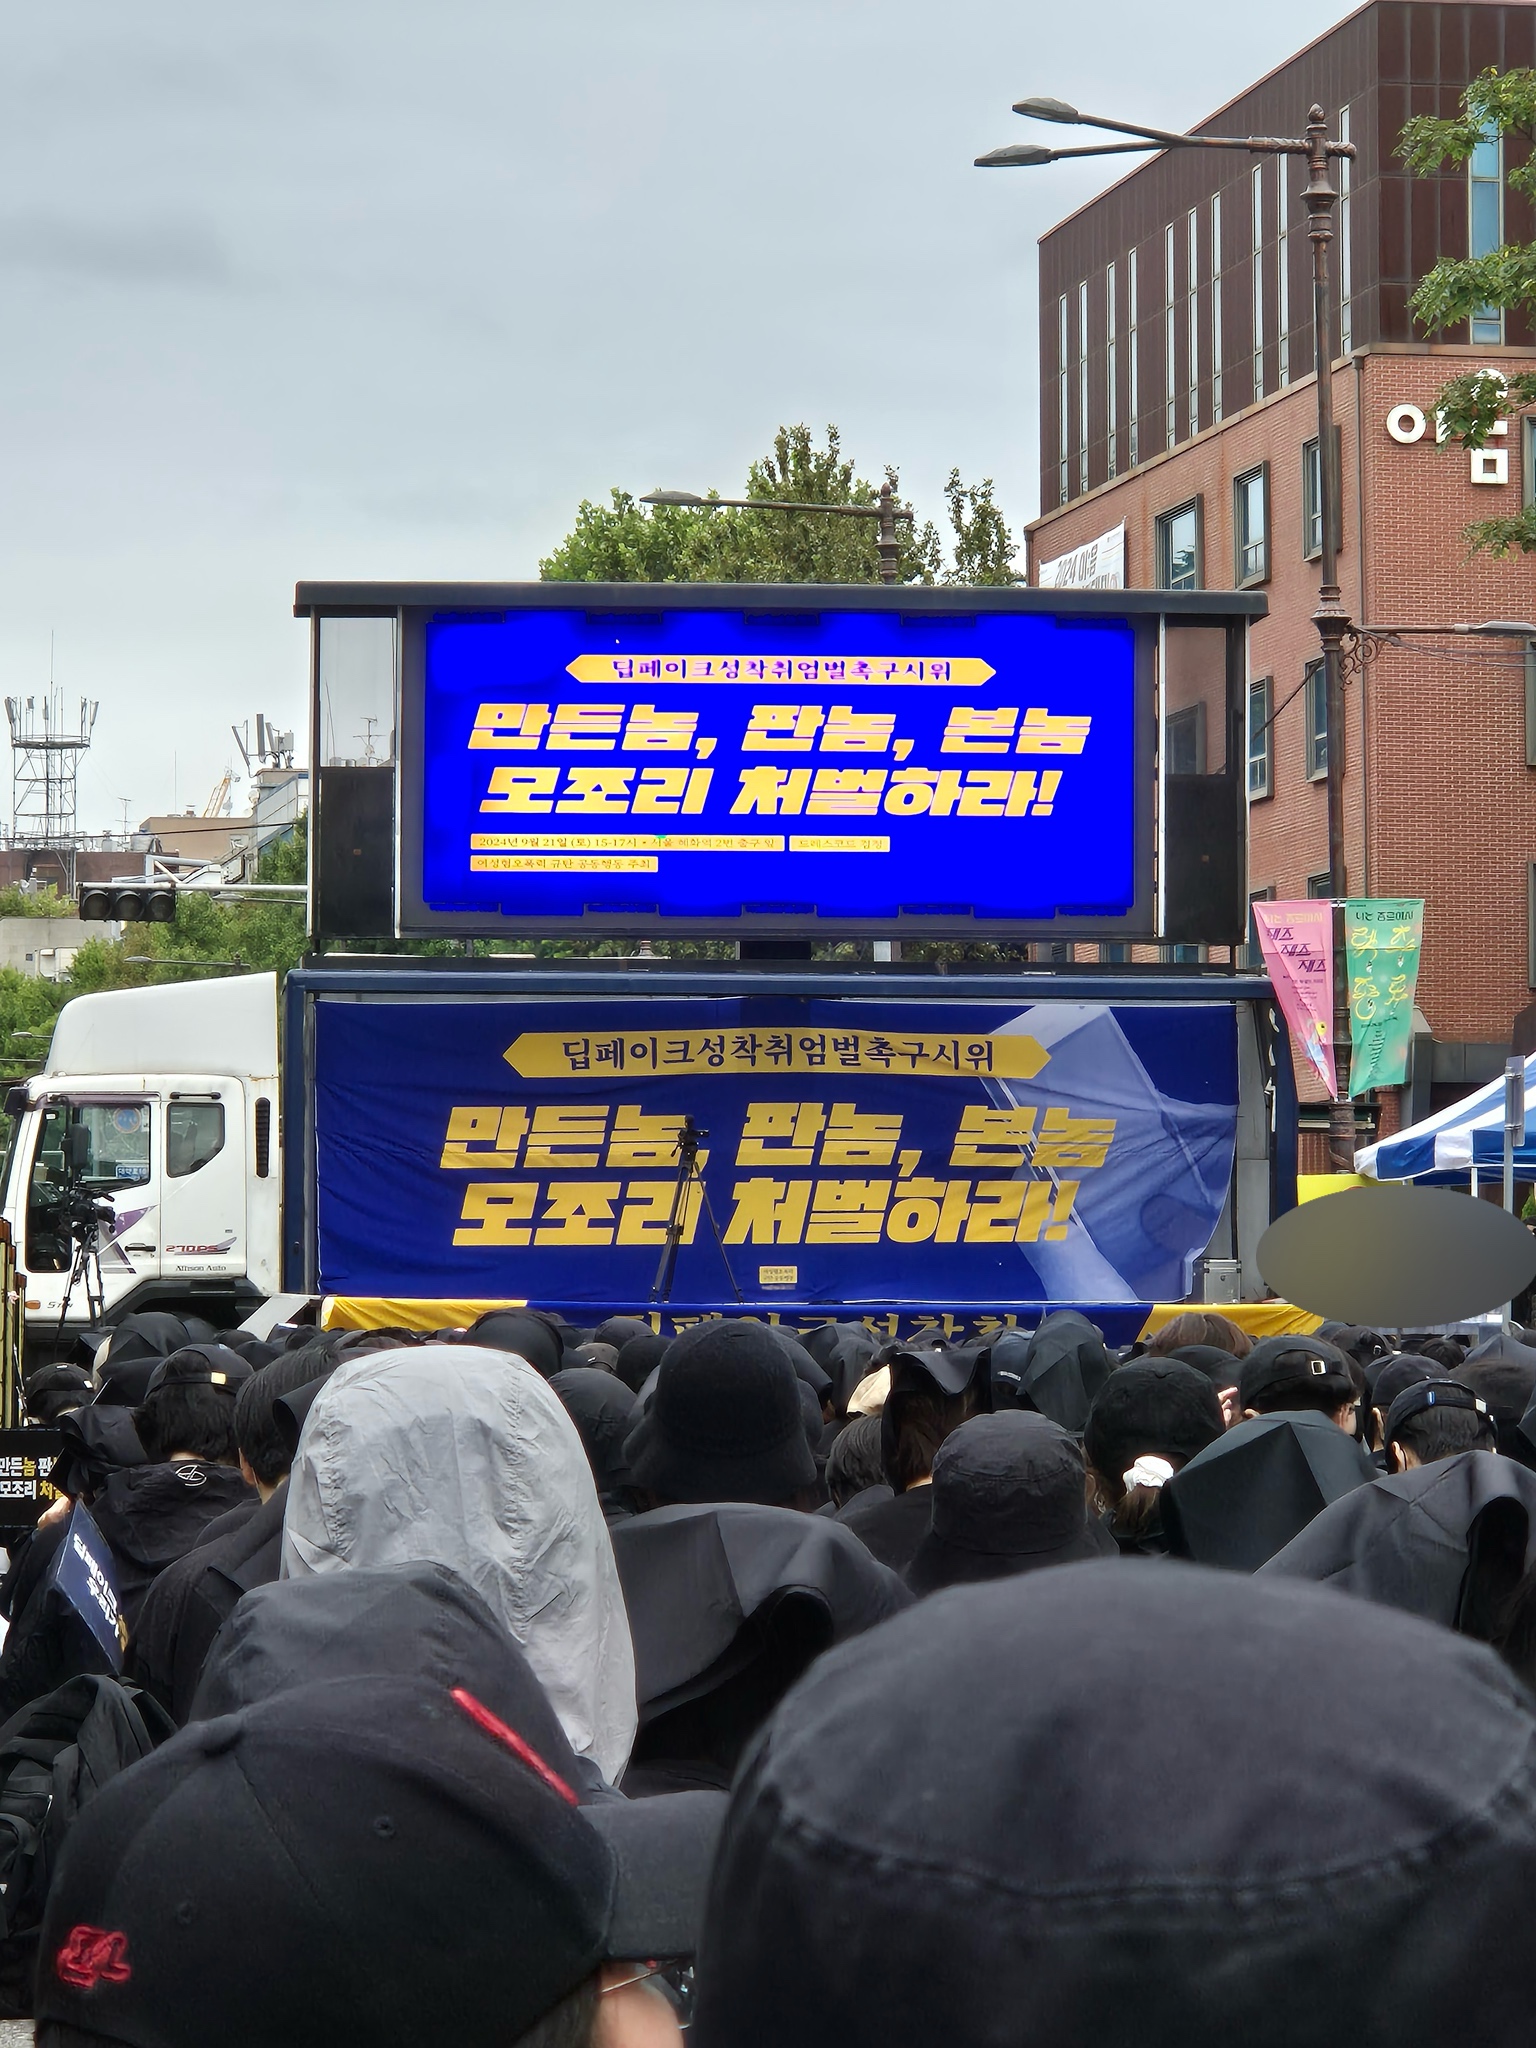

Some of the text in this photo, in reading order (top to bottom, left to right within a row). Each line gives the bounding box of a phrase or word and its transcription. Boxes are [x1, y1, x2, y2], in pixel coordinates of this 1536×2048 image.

[612, 658, 951, 682] 딥페이크성착취엄벌촉구시위
[468, 702, 1093, 761] 만든놈, 판놈, 본놈
[479, 765, 1064, 817] 모조리 처벌하라!
[479, 838, 518, 848] 2024년
[521, 838, 540, 848] 9월
[542, 838, 567, 848] 21일
[571, 838, 591, 848] (토)
[595, 838, 637, 848] 15-17시
[798, 838, 857, 849] 드레스코드
[562, 1032, 995, 1073] 딥페이크성착취엄벌촉구시위
[735, 1101, 923, 1177] 판놈,
[949, 1104, 1117, 1168] 본놈
[451, 1176, 1081, 1246] 모조리 처벌하라!
[0, 1456, 58, 1477] 만든놈 판
[0, 1480, 37, 1500] 모조리
